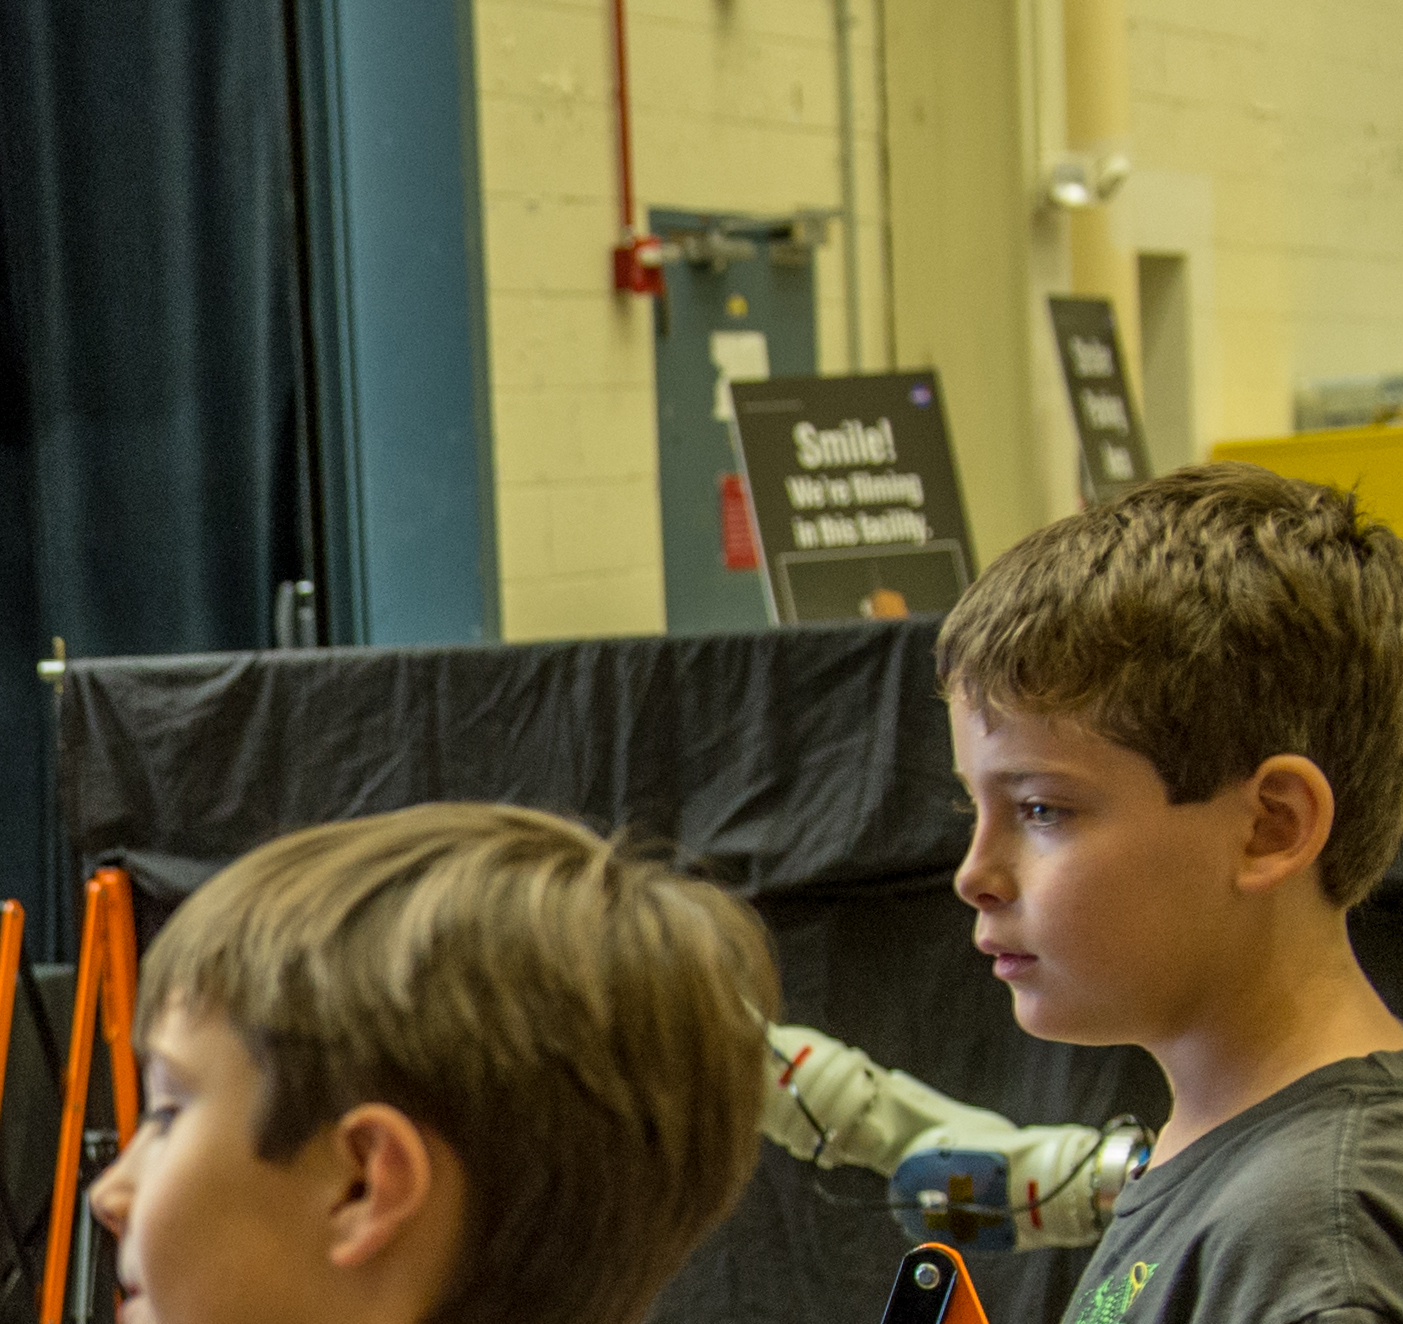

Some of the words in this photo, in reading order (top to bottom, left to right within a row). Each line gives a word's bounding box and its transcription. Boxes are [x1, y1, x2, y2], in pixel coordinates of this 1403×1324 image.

[792, 415, 897, 471] Smile!
[785, 473, 851, 511] We're
[849, 469, 925, 508] filming
